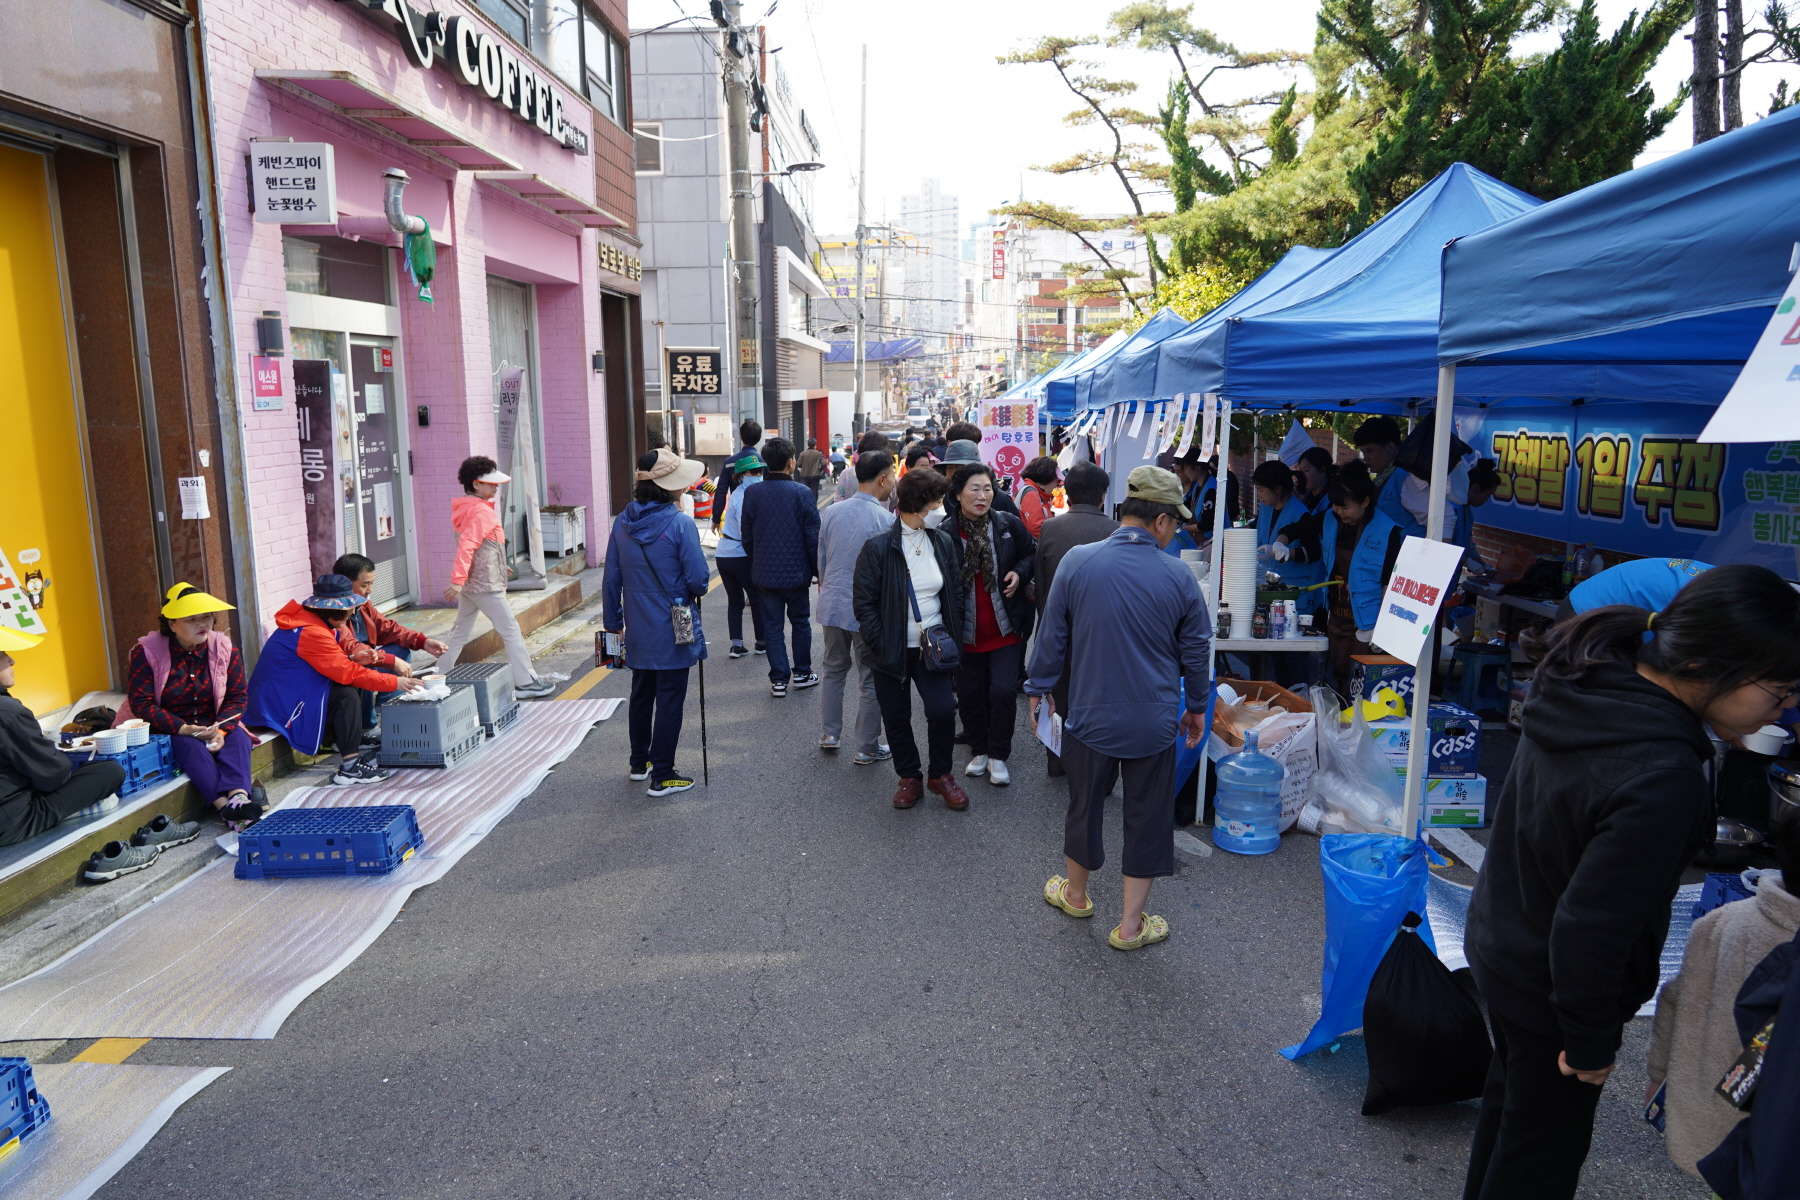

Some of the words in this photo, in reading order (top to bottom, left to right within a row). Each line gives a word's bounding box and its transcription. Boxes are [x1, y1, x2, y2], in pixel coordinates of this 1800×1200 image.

[456, 15, 566, 145] COFFEE
[258, 155, 321, 169] 케빈즈파이
[266, 176, 316, 190] 핸드드립
[267, 197, 317, 211] 눈꽃빙수
[677, 355, 712, 373] 유료
[258, 370, 278, 384] 에스원
[672, 374, 718, 393] 주차장
[505, 380, 520, 389] OUT
[1002, 432, 1034, 444] 탕후루
[1492, 431, 1570, 510] 강행발
[1576, 436, 1631, 520] 1일
[1634, 437, 1727, 532] 주점
[22, 552, 38, 560] READY!
[1432, 731, 1477, 759] Cass
[1455, 781, 1465, 791] 참
[1455, 790, 1468, 801] 이슬
